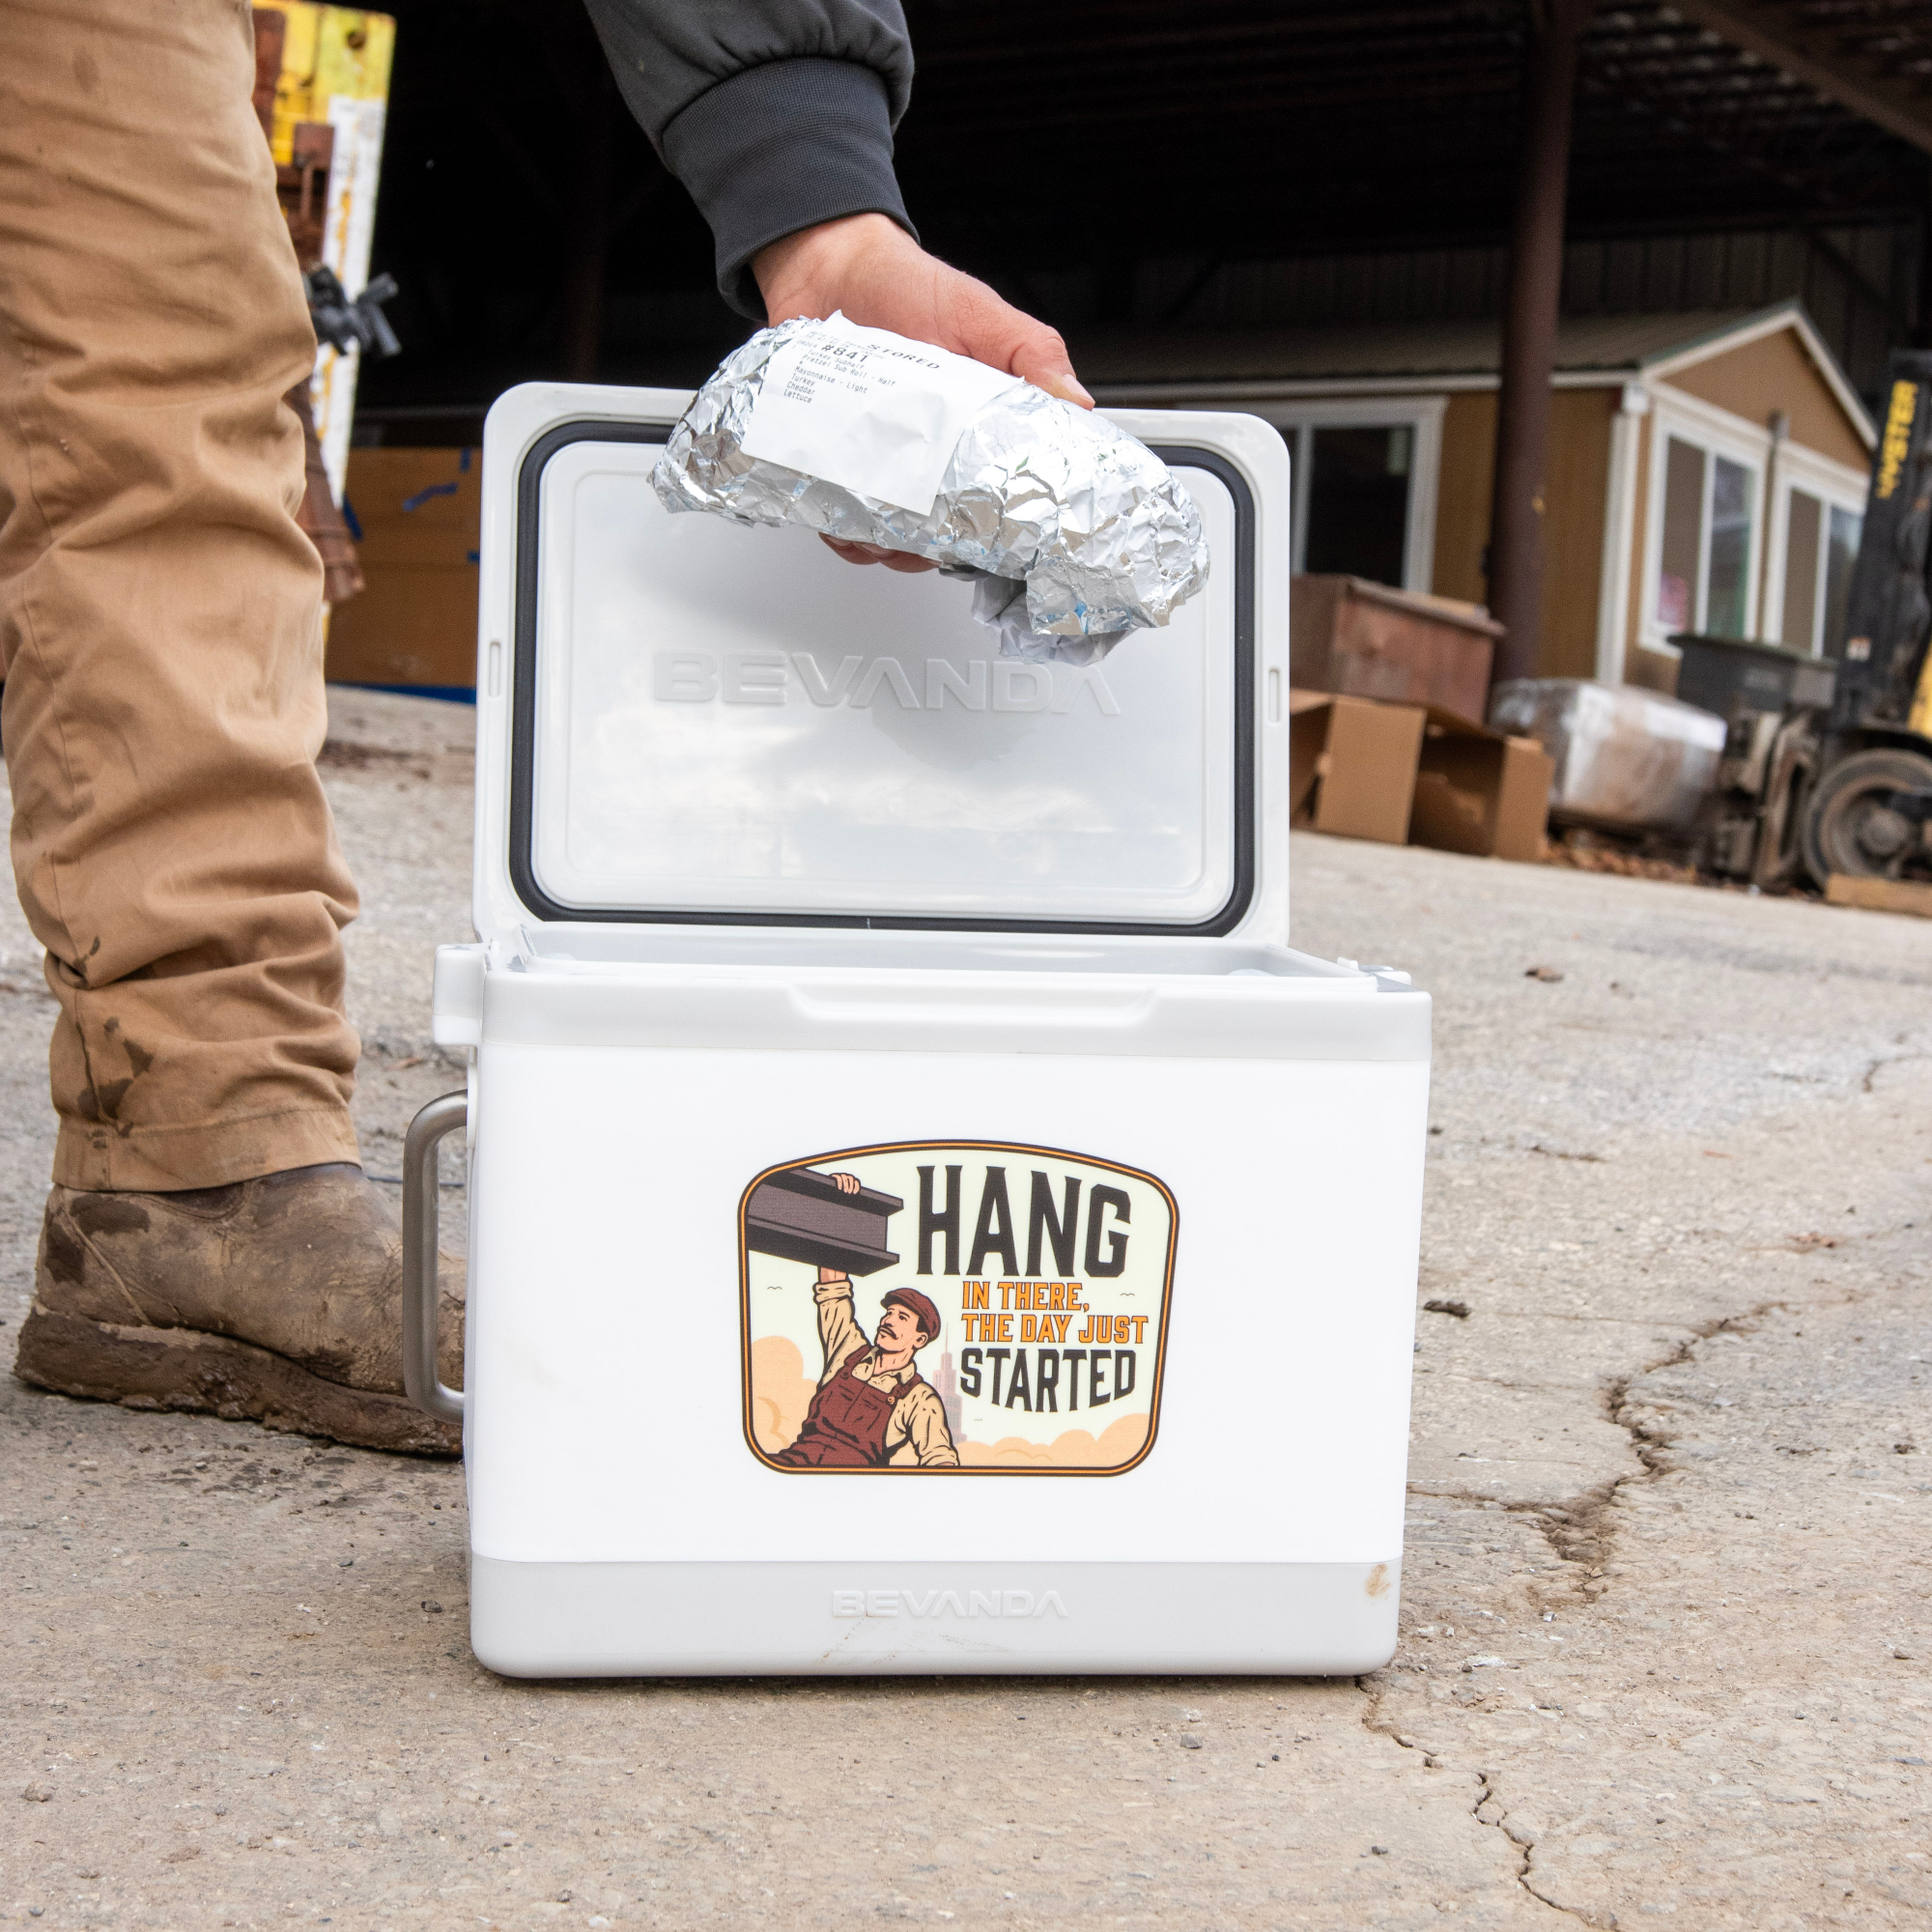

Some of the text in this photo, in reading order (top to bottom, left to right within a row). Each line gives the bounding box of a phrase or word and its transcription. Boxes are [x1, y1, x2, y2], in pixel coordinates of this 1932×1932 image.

[809, 349, 831, 360] Turkey
[821, 344, 868, 362] #841
[867, 344, 940, 369] STORED
[791, 373, 816, 387] Turkey
[795, 365, 836, 384] Mayonnaise
[846, 382, 868, 394] Light
[803, 355, 831, 367] Pretzel
[834, 363, 847, 373] Sub
[850, 368, 867, 379] Roll
[878, 377, 895, 386] Half
[783, 389, 812, 404] Lettuce
[786, 382, 816, 395] Cheddar
[653, 648, 1122, 716] BEVANDA
[916, 1164, 1132, 1278] HANG
[962, 1281, 1091, 1314] IN THERE,
[960, 1314, 1150, 1345] THE DAY JUST
[959, 1348, 1137, 1413] STARTED
[832, 1589, 1068, 1618] BEVANDA
